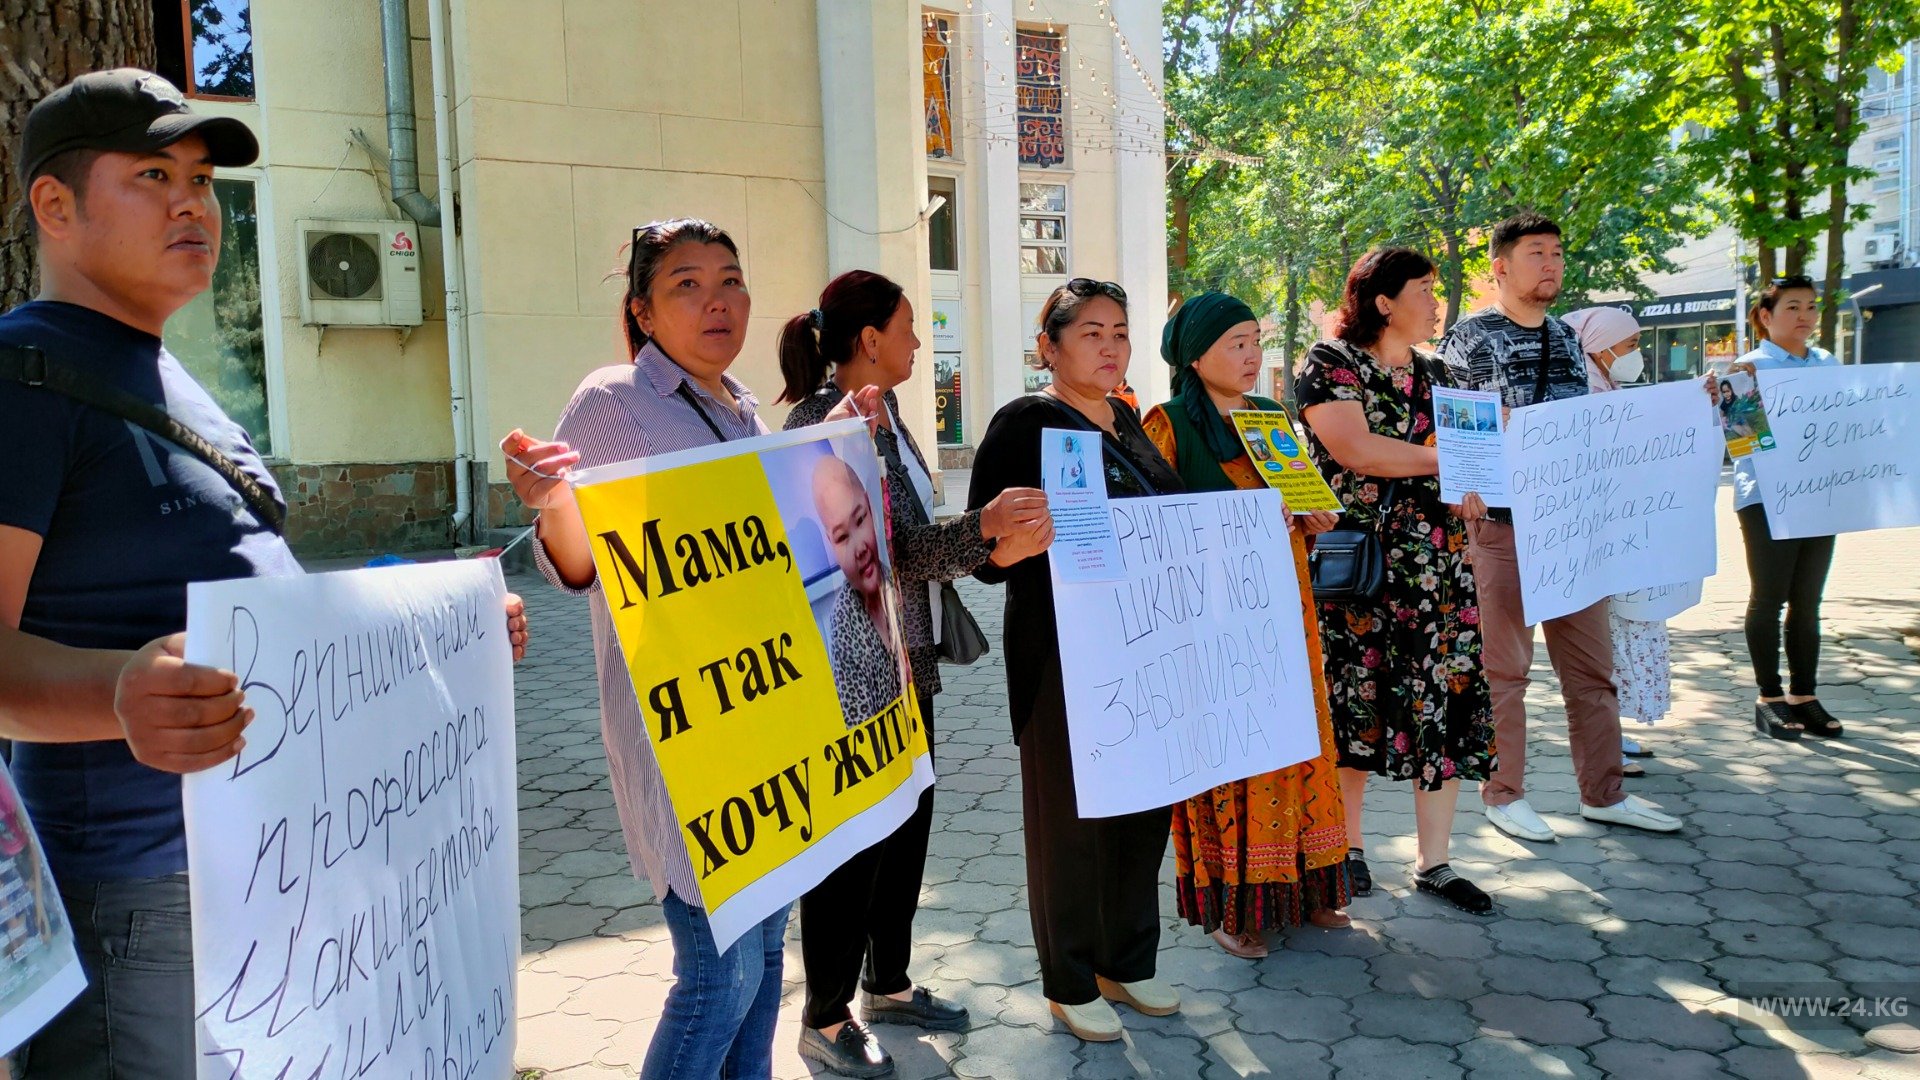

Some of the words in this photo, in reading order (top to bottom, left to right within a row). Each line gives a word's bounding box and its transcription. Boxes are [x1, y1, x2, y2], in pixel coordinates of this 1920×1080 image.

[1672, 302, 1683, 314] &
[1521, 400, 1644, 451] Балдар
[1798, 418, 1887, 462] дети
[597, 512, 793, 611] Мама,
[1112, 502, 1209, 572] РНИТЕ
[1216, 494, 1272, 549] НАМ
[1114, 561, 1206, 646] ШКОЛУ
[648, 672, 693, 743] я
[700, 631, 803, 715] так
[244, 704, 489, 938] профессора
[685, 756, 813, 881] хочу
